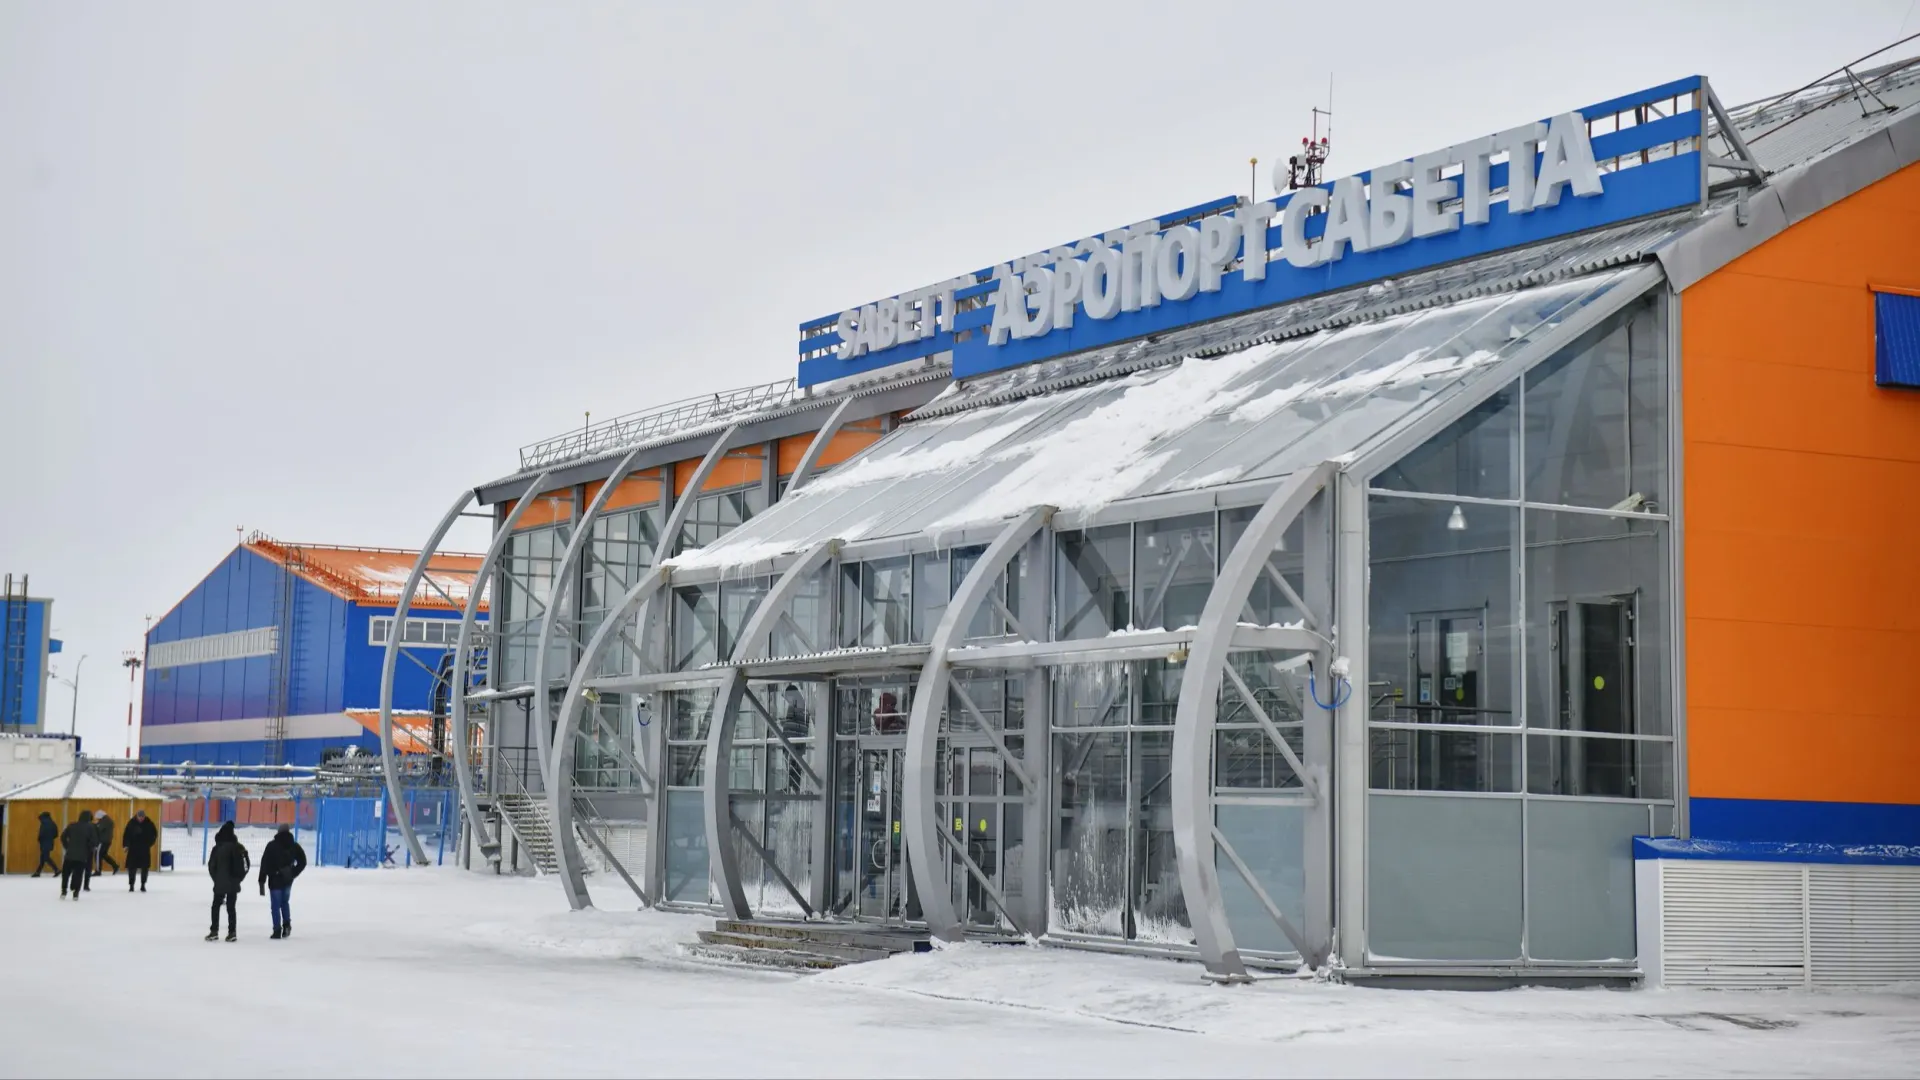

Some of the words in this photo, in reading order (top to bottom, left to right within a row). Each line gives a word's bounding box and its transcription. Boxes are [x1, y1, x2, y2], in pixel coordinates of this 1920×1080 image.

[988, 202, 1276, 346] АЭРОПОРТ
[1282, 111, 1604, 268] САБЕТТА
[837, 274, 978, 360] SABETT
